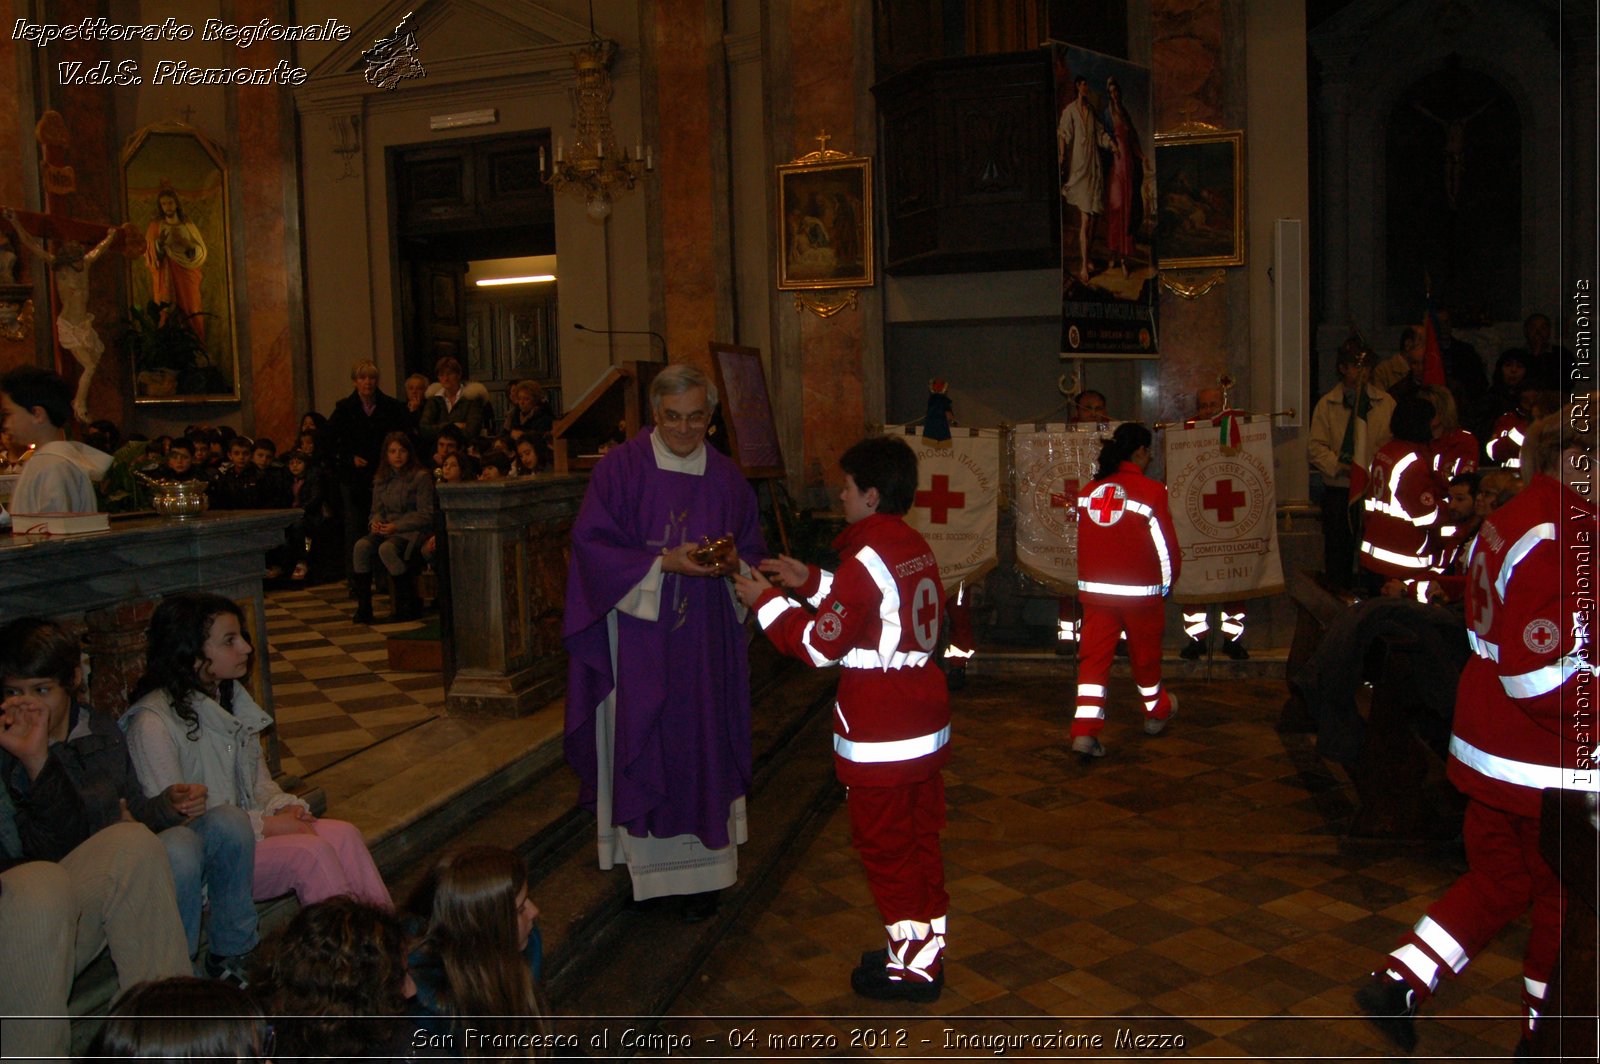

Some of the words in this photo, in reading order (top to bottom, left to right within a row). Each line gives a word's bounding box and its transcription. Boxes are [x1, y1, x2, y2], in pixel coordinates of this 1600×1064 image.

[919, 448, 954, 461] ROSSA
[1171, 463, 1195, 499] CROCE
[1195, 545, 1233, 554] COMITATO
[1234, 543, 1260, 552] LOCALE
